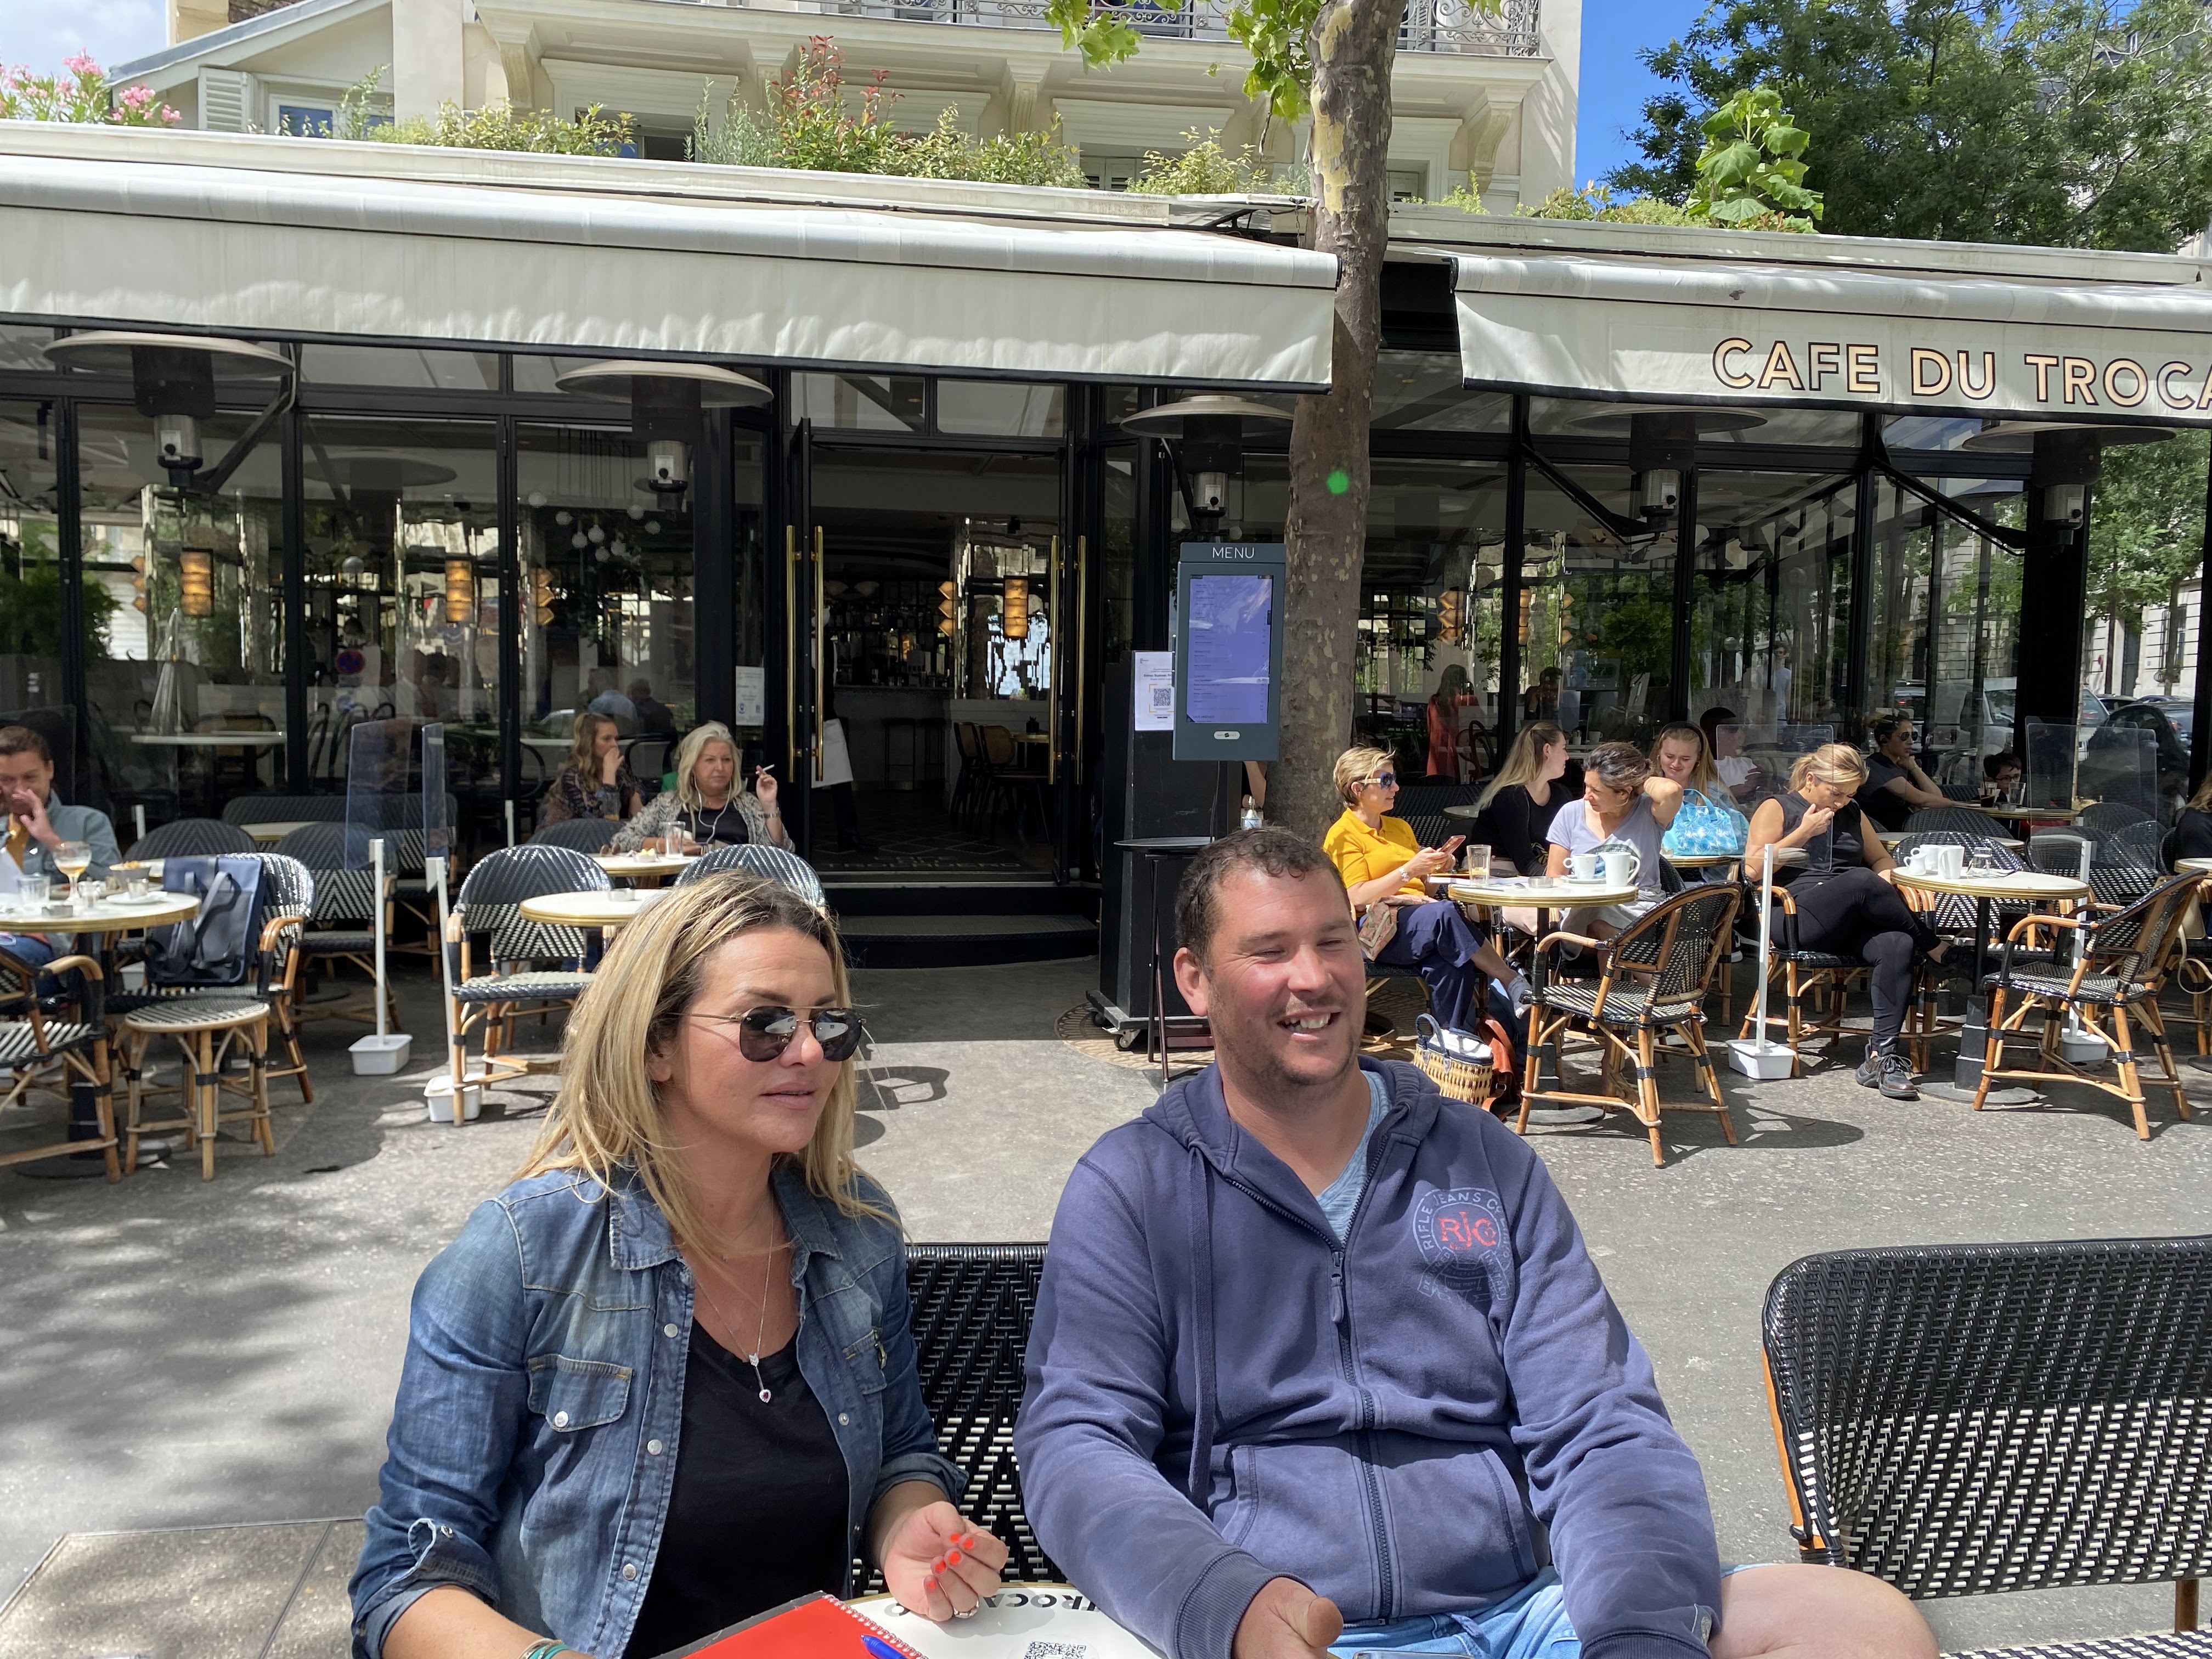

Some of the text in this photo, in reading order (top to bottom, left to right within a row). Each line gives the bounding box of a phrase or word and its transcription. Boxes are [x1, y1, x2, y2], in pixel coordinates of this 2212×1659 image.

[1713, 337, 1881, 393] CAFE
[1910, 347, 1996, 400] DU
[1212, 546, 1256, 559] MENU
[1417, 1206, 1435, 1250] RIFLE
[1433, 1192, 1481, 1206] JEANS
